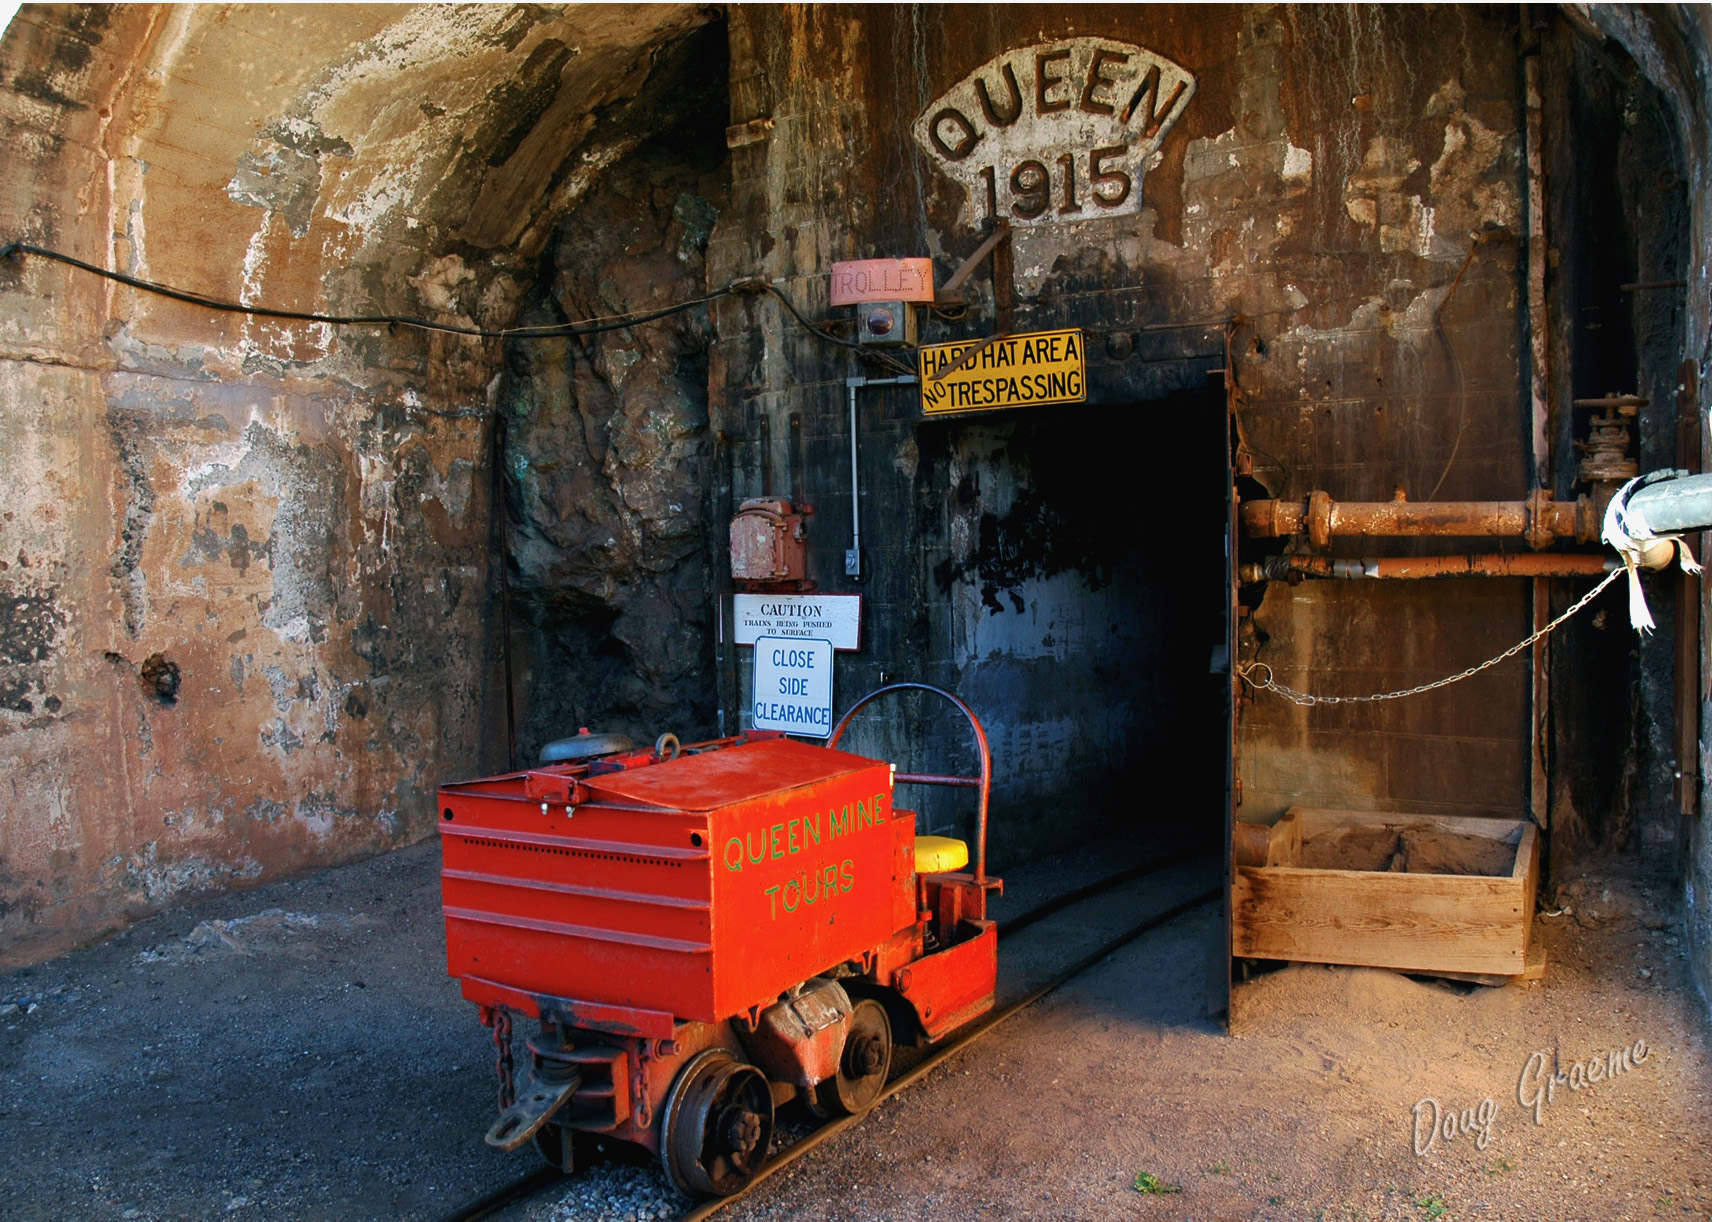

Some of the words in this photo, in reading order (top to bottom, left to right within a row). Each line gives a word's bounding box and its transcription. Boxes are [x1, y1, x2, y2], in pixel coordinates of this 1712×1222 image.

[928, 48, 1188, 162] QUEEN
[978, 145, 1132, 220] 1915
[923, 346, 978, 375] HARD
[981, 340, 1018, 369] HAT
[1022, 335, 1079, 364] AREA
[923, 381, 947, 408] NO
[947, 370, 1081, 407] TRESPASSING
[760, 604, 822, 617] CAUTION
[776, 620, 799, 628] BEING
[803, 621, 833, 629] PUSHED
[781, 629, 814, 637] SURFACE
[772, 649, 815, 669] CLOSE
[778, 676, 809, 696] SIDE
[755, 702, 830, 726] CLEARANCE
[724, 813, 820, 872] QUEEN
[830, 793, 885, 840] MINE
[764, 859, 854, 920] TOURS
